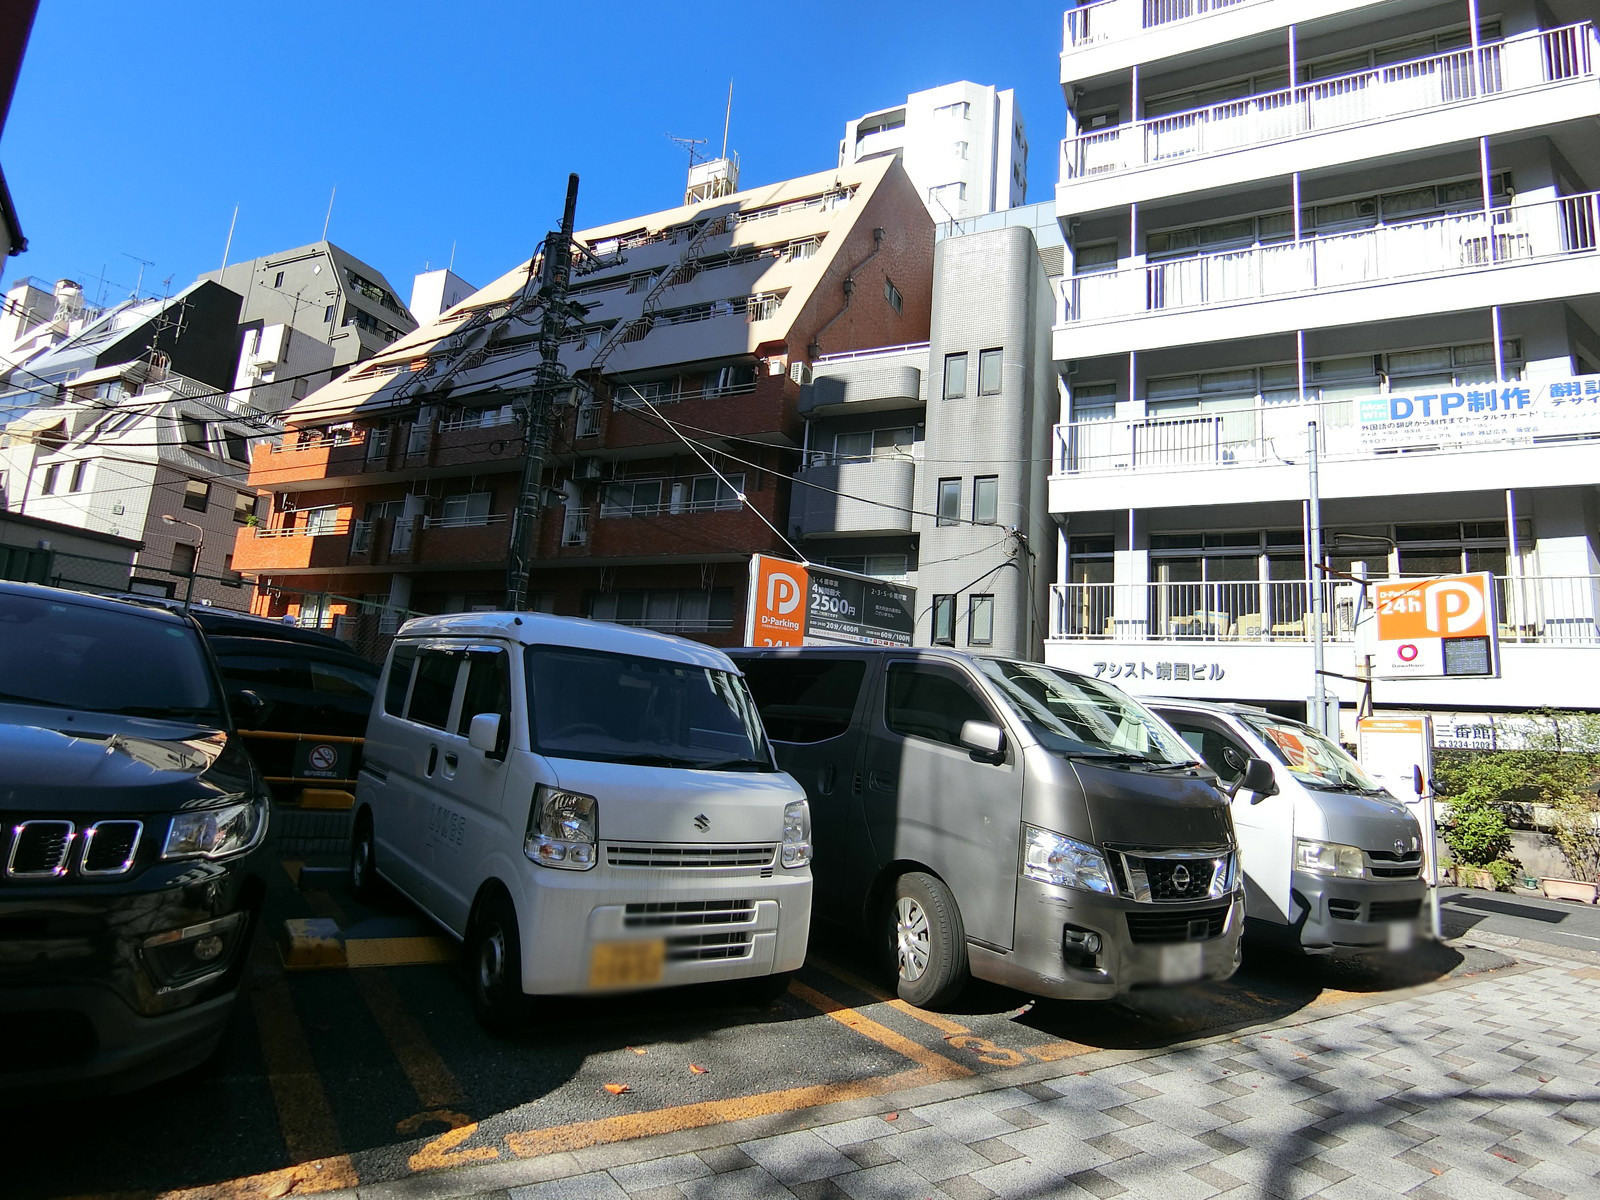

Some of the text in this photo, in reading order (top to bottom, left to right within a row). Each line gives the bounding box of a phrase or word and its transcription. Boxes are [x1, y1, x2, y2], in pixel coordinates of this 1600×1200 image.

[1390, 387, 1531, 420] DTP制作
[810, 593, 856, 616] 2500円
[1380, 597, 1421, 615] 24h
[761, 615, 800, 632] D-Parking
[1093, 662, 1225, 681] アシスト靖国ビル
[1436, 724, 1491, 739] 三番館
[396, 1109, 499, 1172] 2
